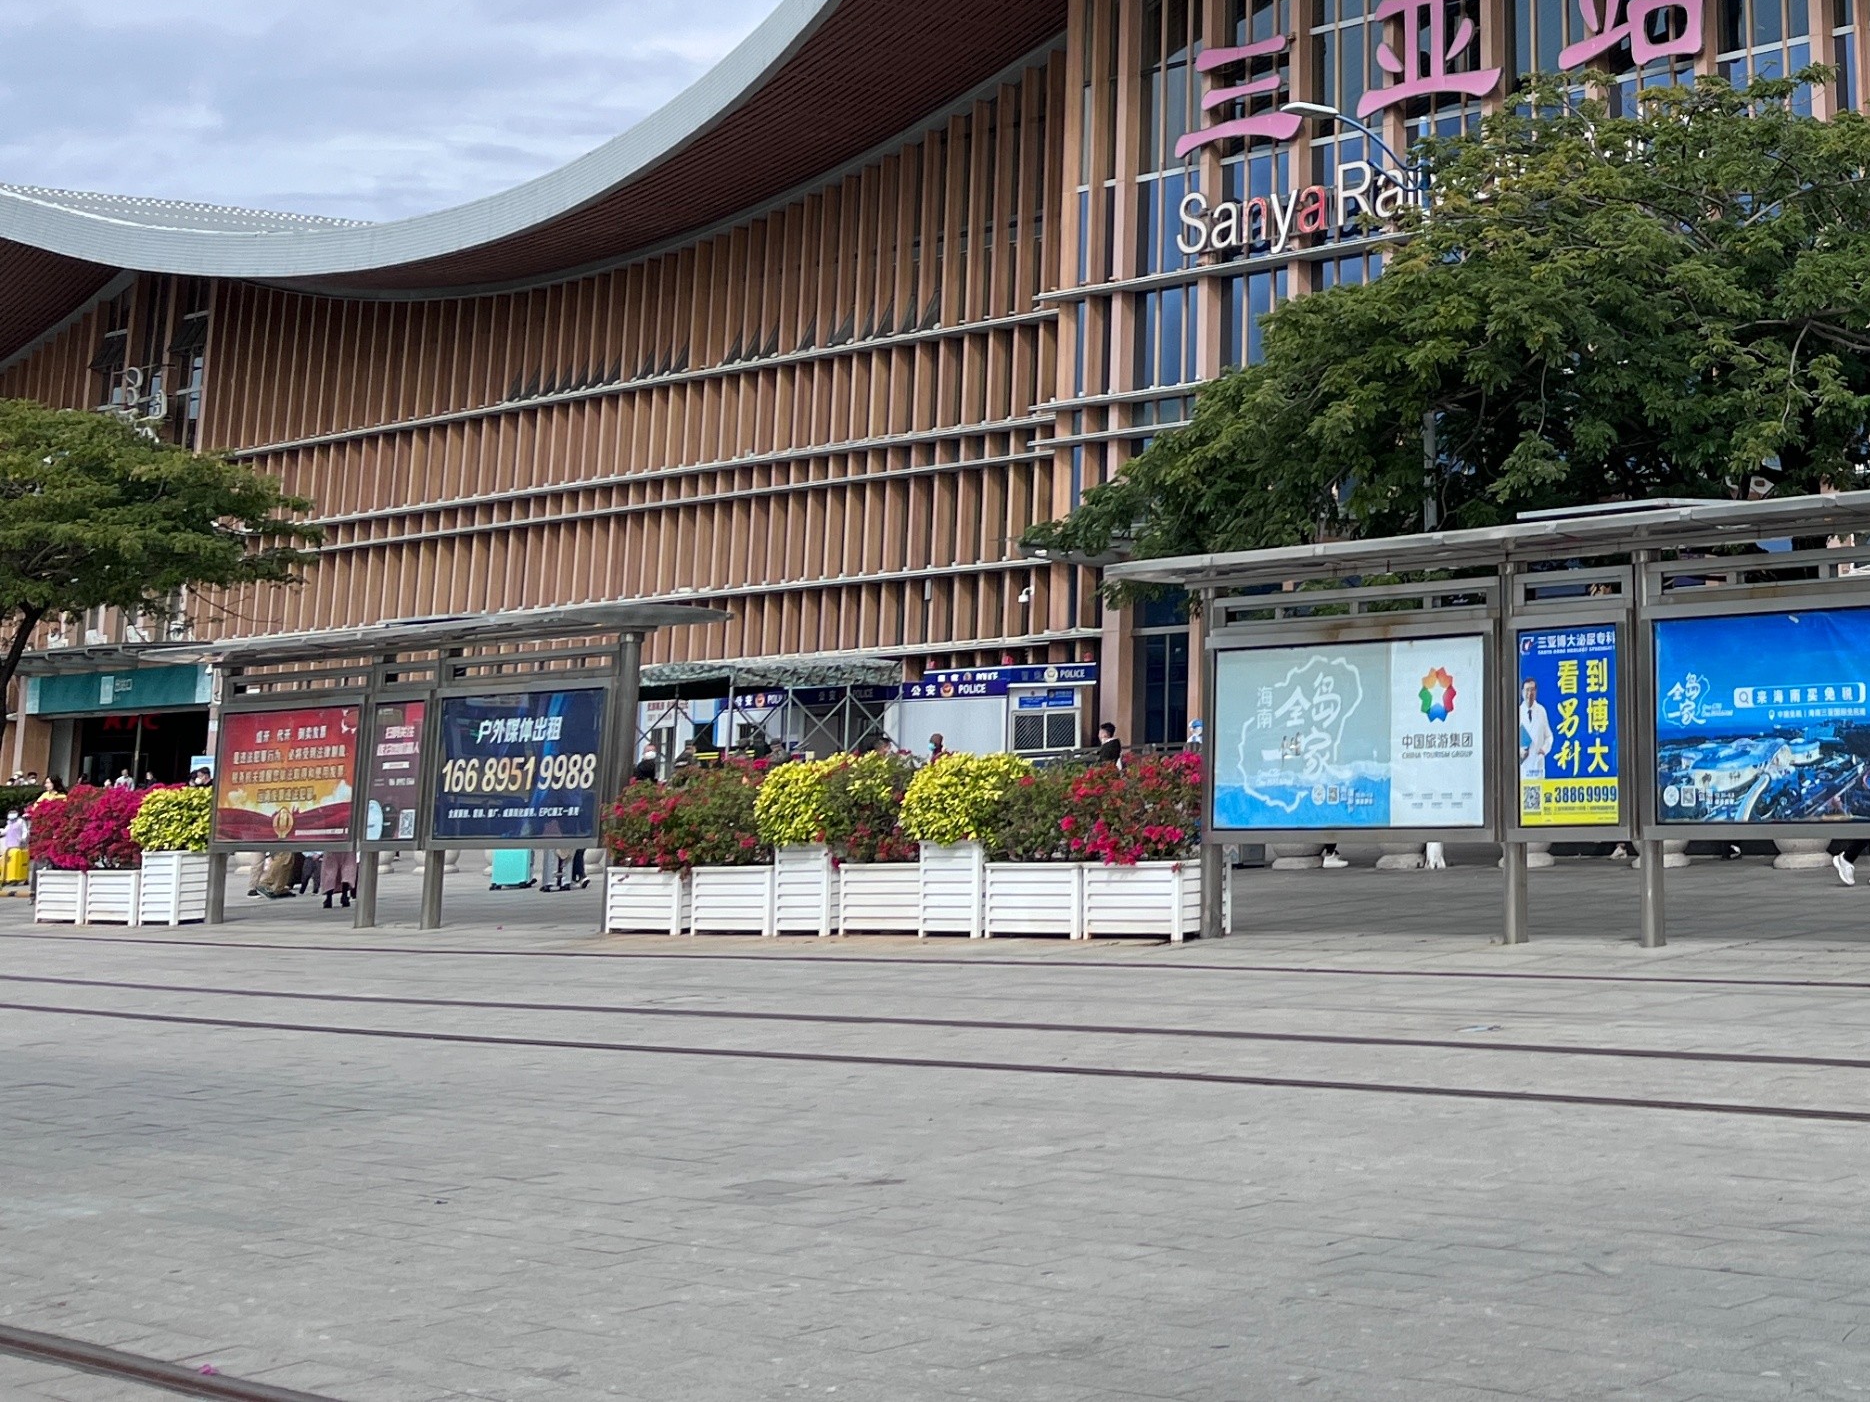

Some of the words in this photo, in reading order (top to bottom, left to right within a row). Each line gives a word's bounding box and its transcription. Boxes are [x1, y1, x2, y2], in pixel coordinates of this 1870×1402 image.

[1176, 185, 1327, 254] Sanya
[911, 684, 936, 696] 公安
[958, 684, 986, 694] POLICE
[1060, 669, 1085, 678] POLICE
[1257, 686, 1273, 729] 海南
[1553, 660, 1581, 776] 看男科
[1586, 658, 1609, 773] 到博大
[476, 716, 563, 744] 户外媒体出租
[1402, 732, 1473, 749] 中国旅游集团
[442, 758, 479, 793] 166
[481, 756, 536, 792] 8951
[537, 753, 597, 790] 9988
